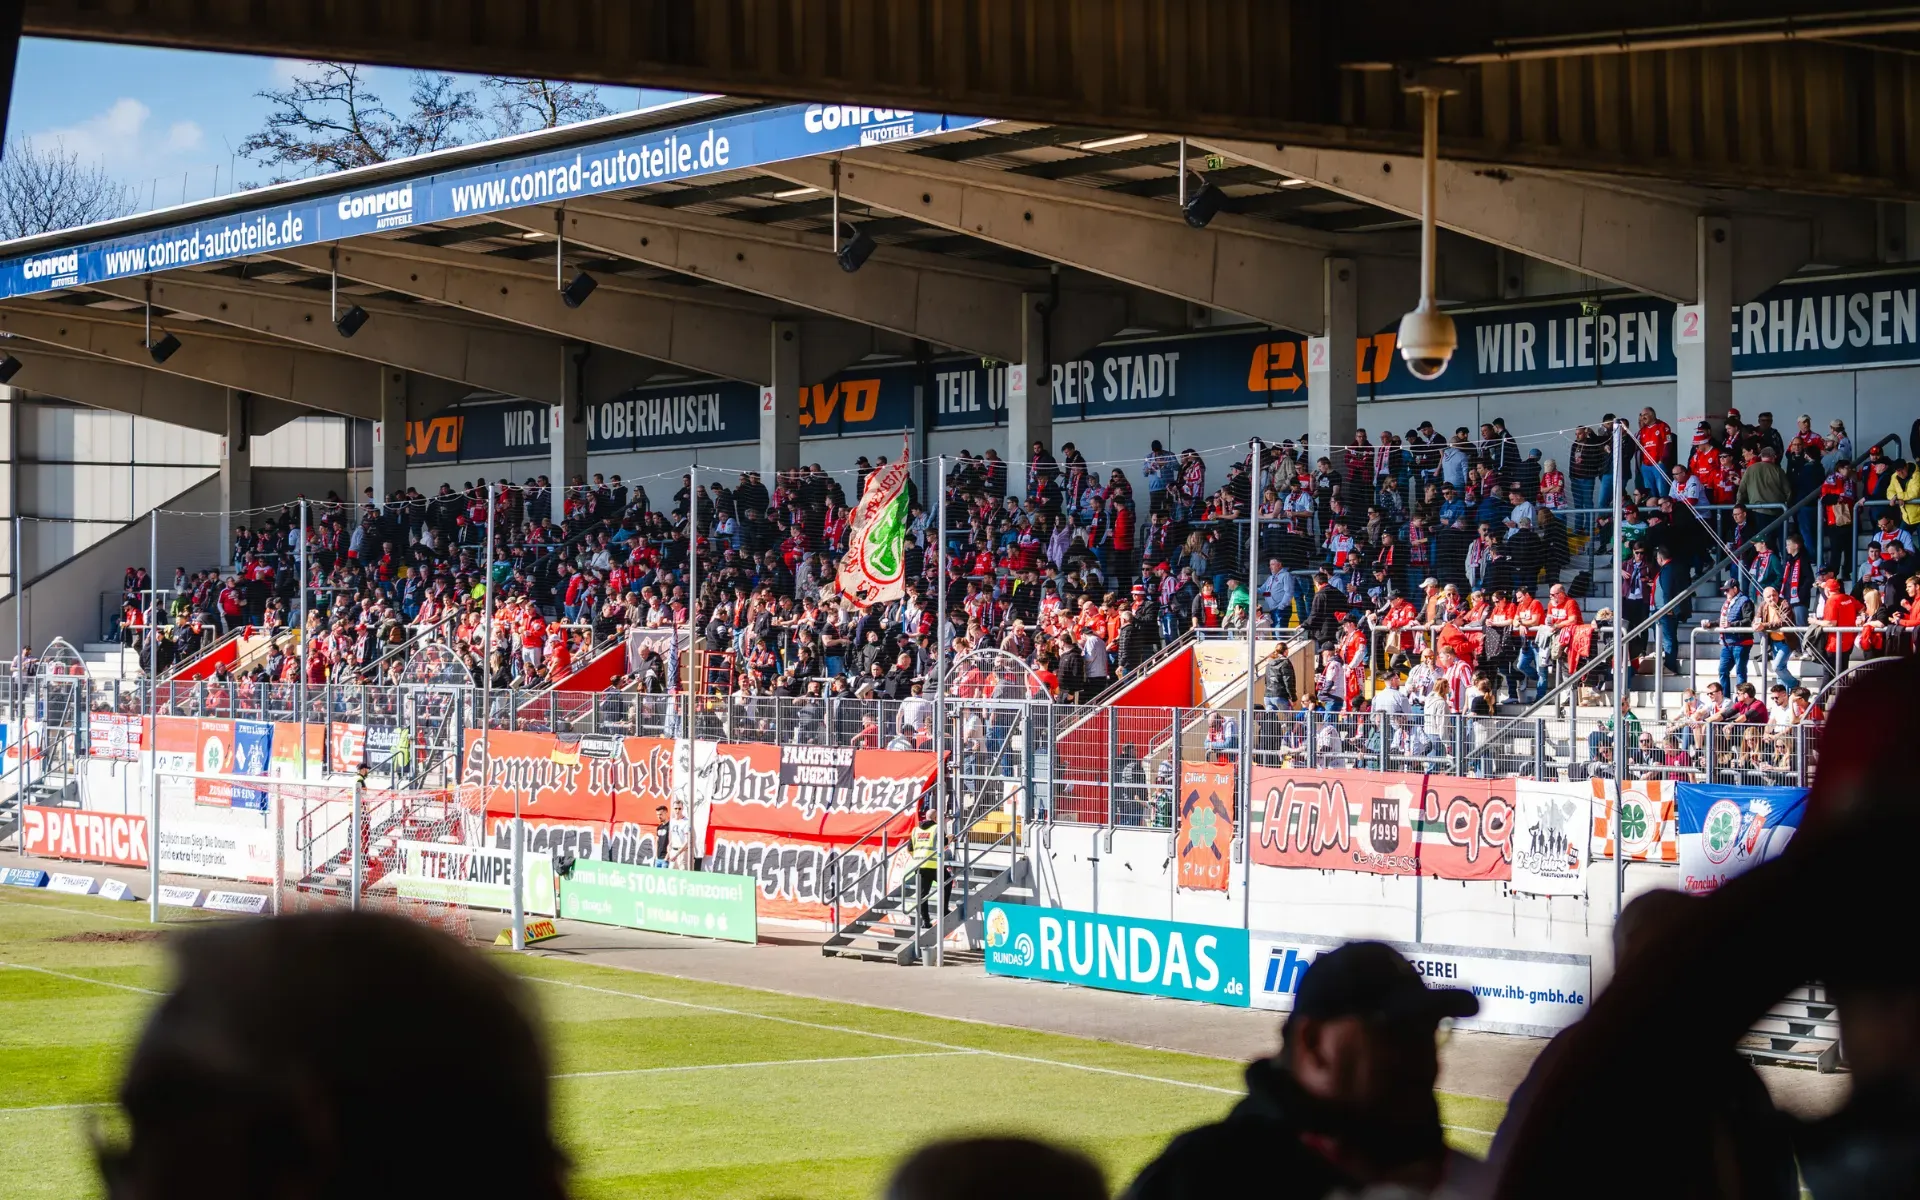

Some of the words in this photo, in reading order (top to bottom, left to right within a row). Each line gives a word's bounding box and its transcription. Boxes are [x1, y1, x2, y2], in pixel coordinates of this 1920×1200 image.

[804, 104, 914, 133] conra
[861, 123, 914, 142] AUTOTEILE
[451, 127, 730, 213] www.conrad-autoteile.de
[338, 183, 413, 220] conrad
[376, 213, 413, 229] AUTOTEILE
[105, 209, 303, 276] www.conrad-autoteile.de
[23, 250, 78, 280] conrad
[1683, 311, 1698, 337] 2
[1476, 321, 1536, 374] WIR
[1548, 310, 1658, 370] LIEBEN
[1312, 343, 1325, 366] 2
[935, 369, 980, 414] TEIL
[1103, 352, 1180, 403] STADT
[1012, 370, 1022, 391] 2
[763, 392, 772, 411] 2
[503, 408, 535, 447] WIR
[600, 393, 725, 440] OBERHAUSEN.
[554, 410, 560, 429] 1
[1184, 771, 1207, 784] Glück
[1260, 778, 1351, 856] HTM
[1371, 801, 1399, 820] HTM
[44, 814, 149, 862] PATRICK
[1371, 824, 1399, 841] 1999
[171, 849, 191, 862] extra
[627, 872, 677, 895] STOAG
[679, 880, 743, 902] Fanzone!
[530, 920, 556, 938] LOTTO
[992, 951, 1025, 966] RUNDAS
[1039, 916, 1220, 993] RUNDAS
[1223, 977, 1244, 995] .de
[1471, 983, 1584, 1006] www.ihb-gmbh.de
